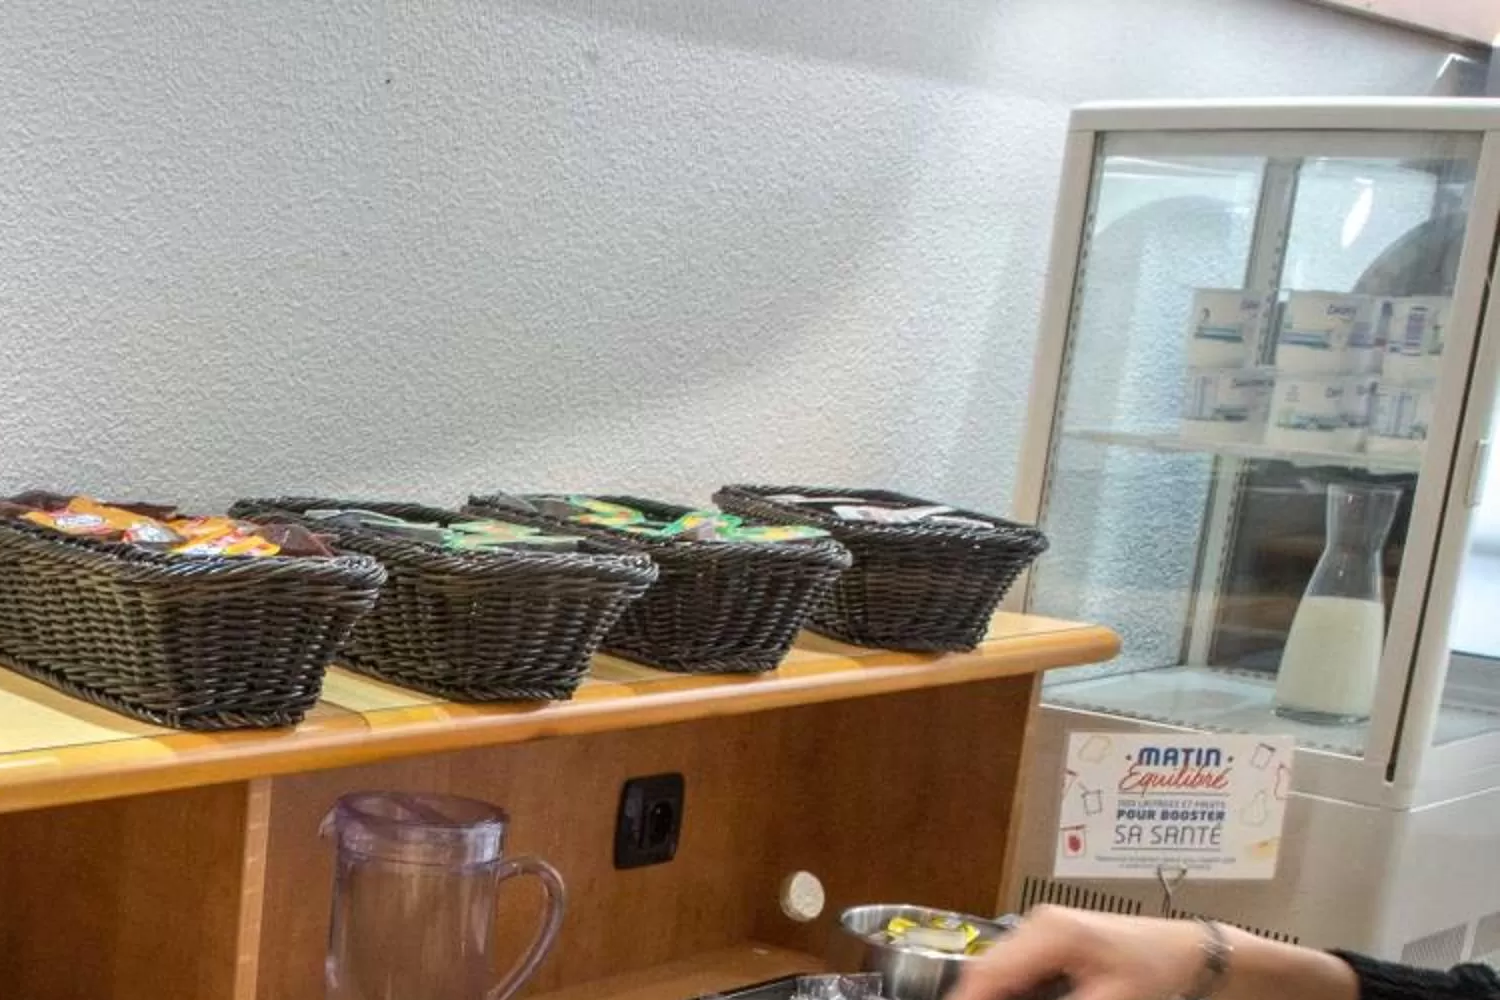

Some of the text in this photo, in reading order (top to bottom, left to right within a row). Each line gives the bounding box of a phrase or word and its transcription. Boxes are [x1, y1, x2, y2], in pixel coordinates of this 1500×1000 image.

[1138, 747, 1222, 767] MATIN
[1117, 809, 1226, 821] POUR BOOSTER
[1113, 822, 1222, 845] SA SANTÉ
